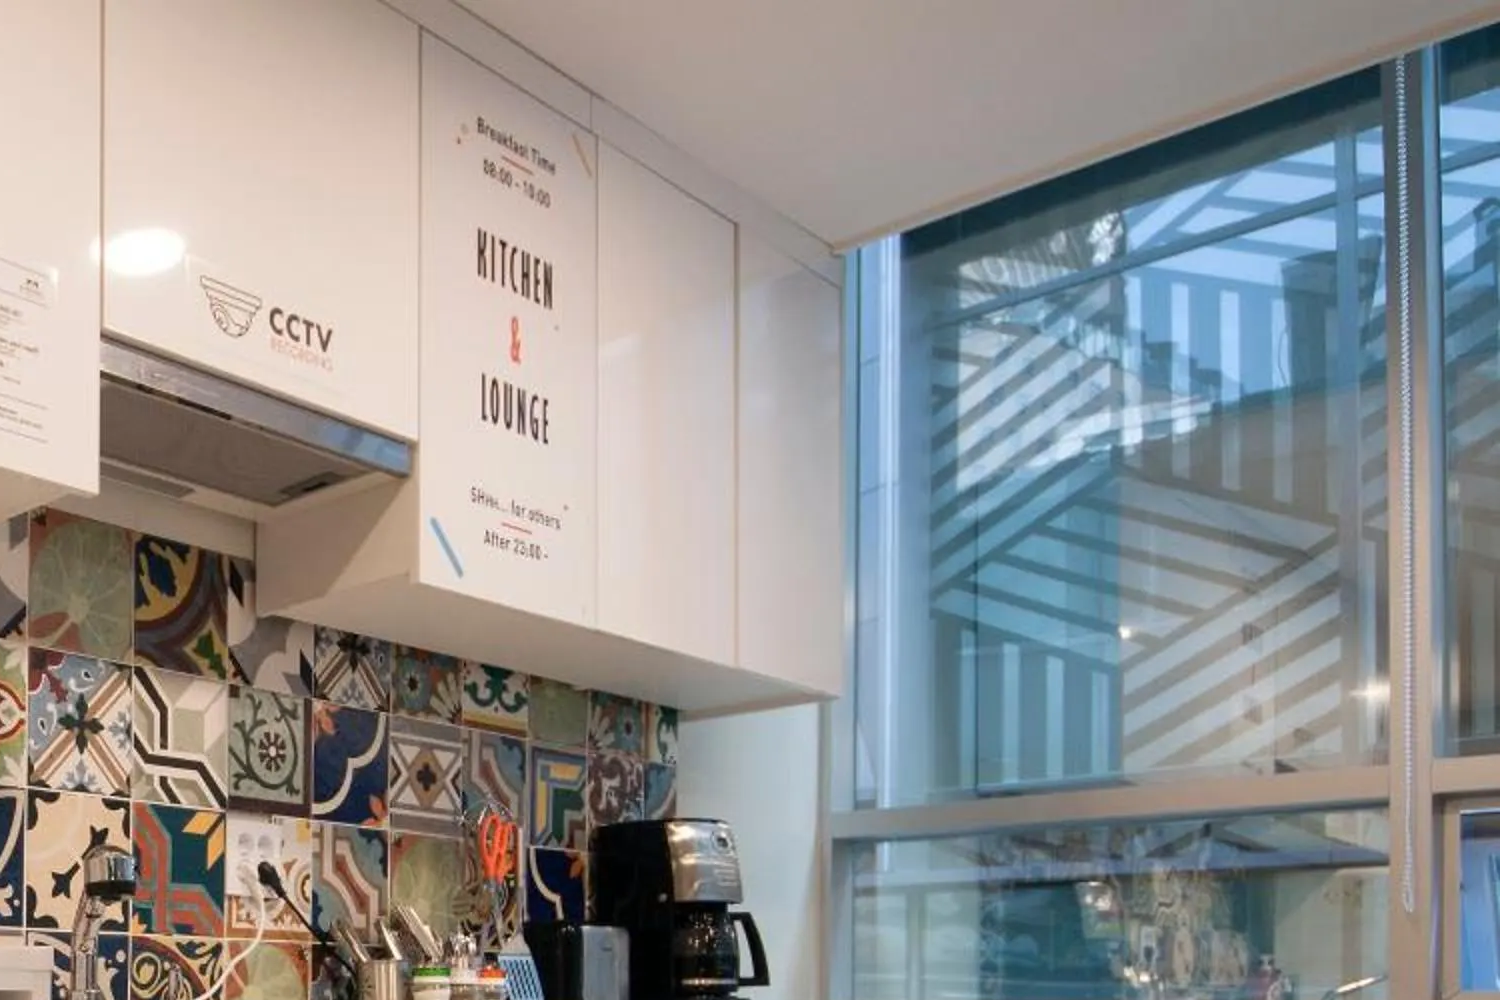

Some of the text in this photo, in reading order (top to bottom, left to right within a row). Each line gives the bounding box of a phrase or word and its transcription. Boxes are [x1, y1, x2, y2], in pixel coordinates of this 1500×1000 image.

[477, 116, 556, 176] Breakfast Time
[477, 227, 553, 310] KITCHEN
[269, 307, 333, 352] CCTV
[510, 315, 521, 365] &
[481, 373, 549, 444] LOUNGE
[483, 529, 510, 551] After
[528, 509, 561, 530] others
